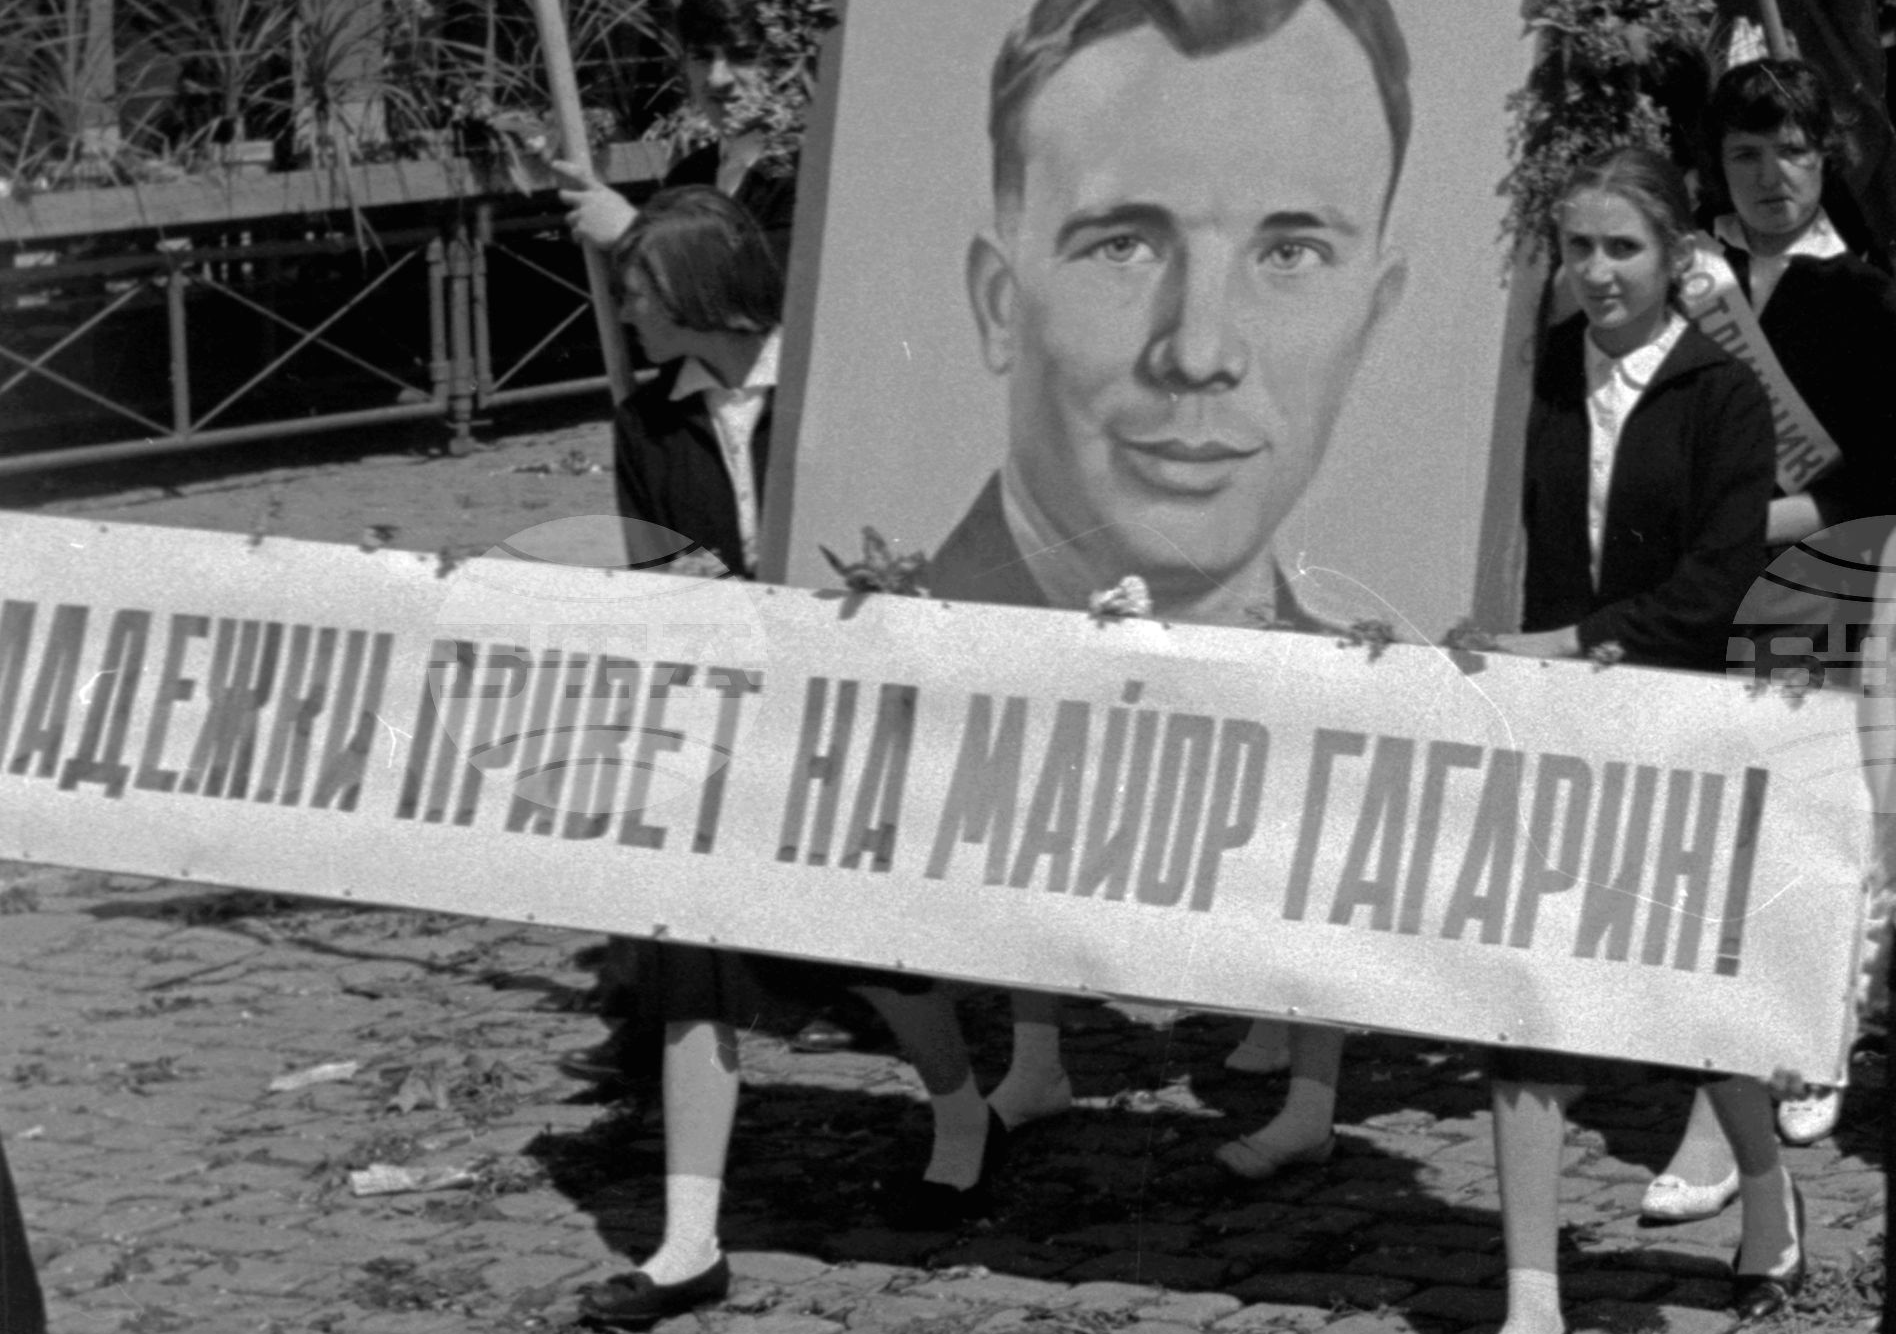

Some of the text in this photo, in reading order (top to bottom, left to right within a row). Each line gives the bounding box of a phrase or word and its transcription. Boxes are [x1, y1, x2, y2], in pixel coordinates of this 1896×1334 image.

[1682, 272, 1825, 484] ОТЛИК
[396, 638, 764, 855] ПРИВЕТ
[776, 675, 919, 873] НА
[925, 679, 1271, 912] МАЙОР
[1281, 728, 1769, 977] ГАГАРИН!
